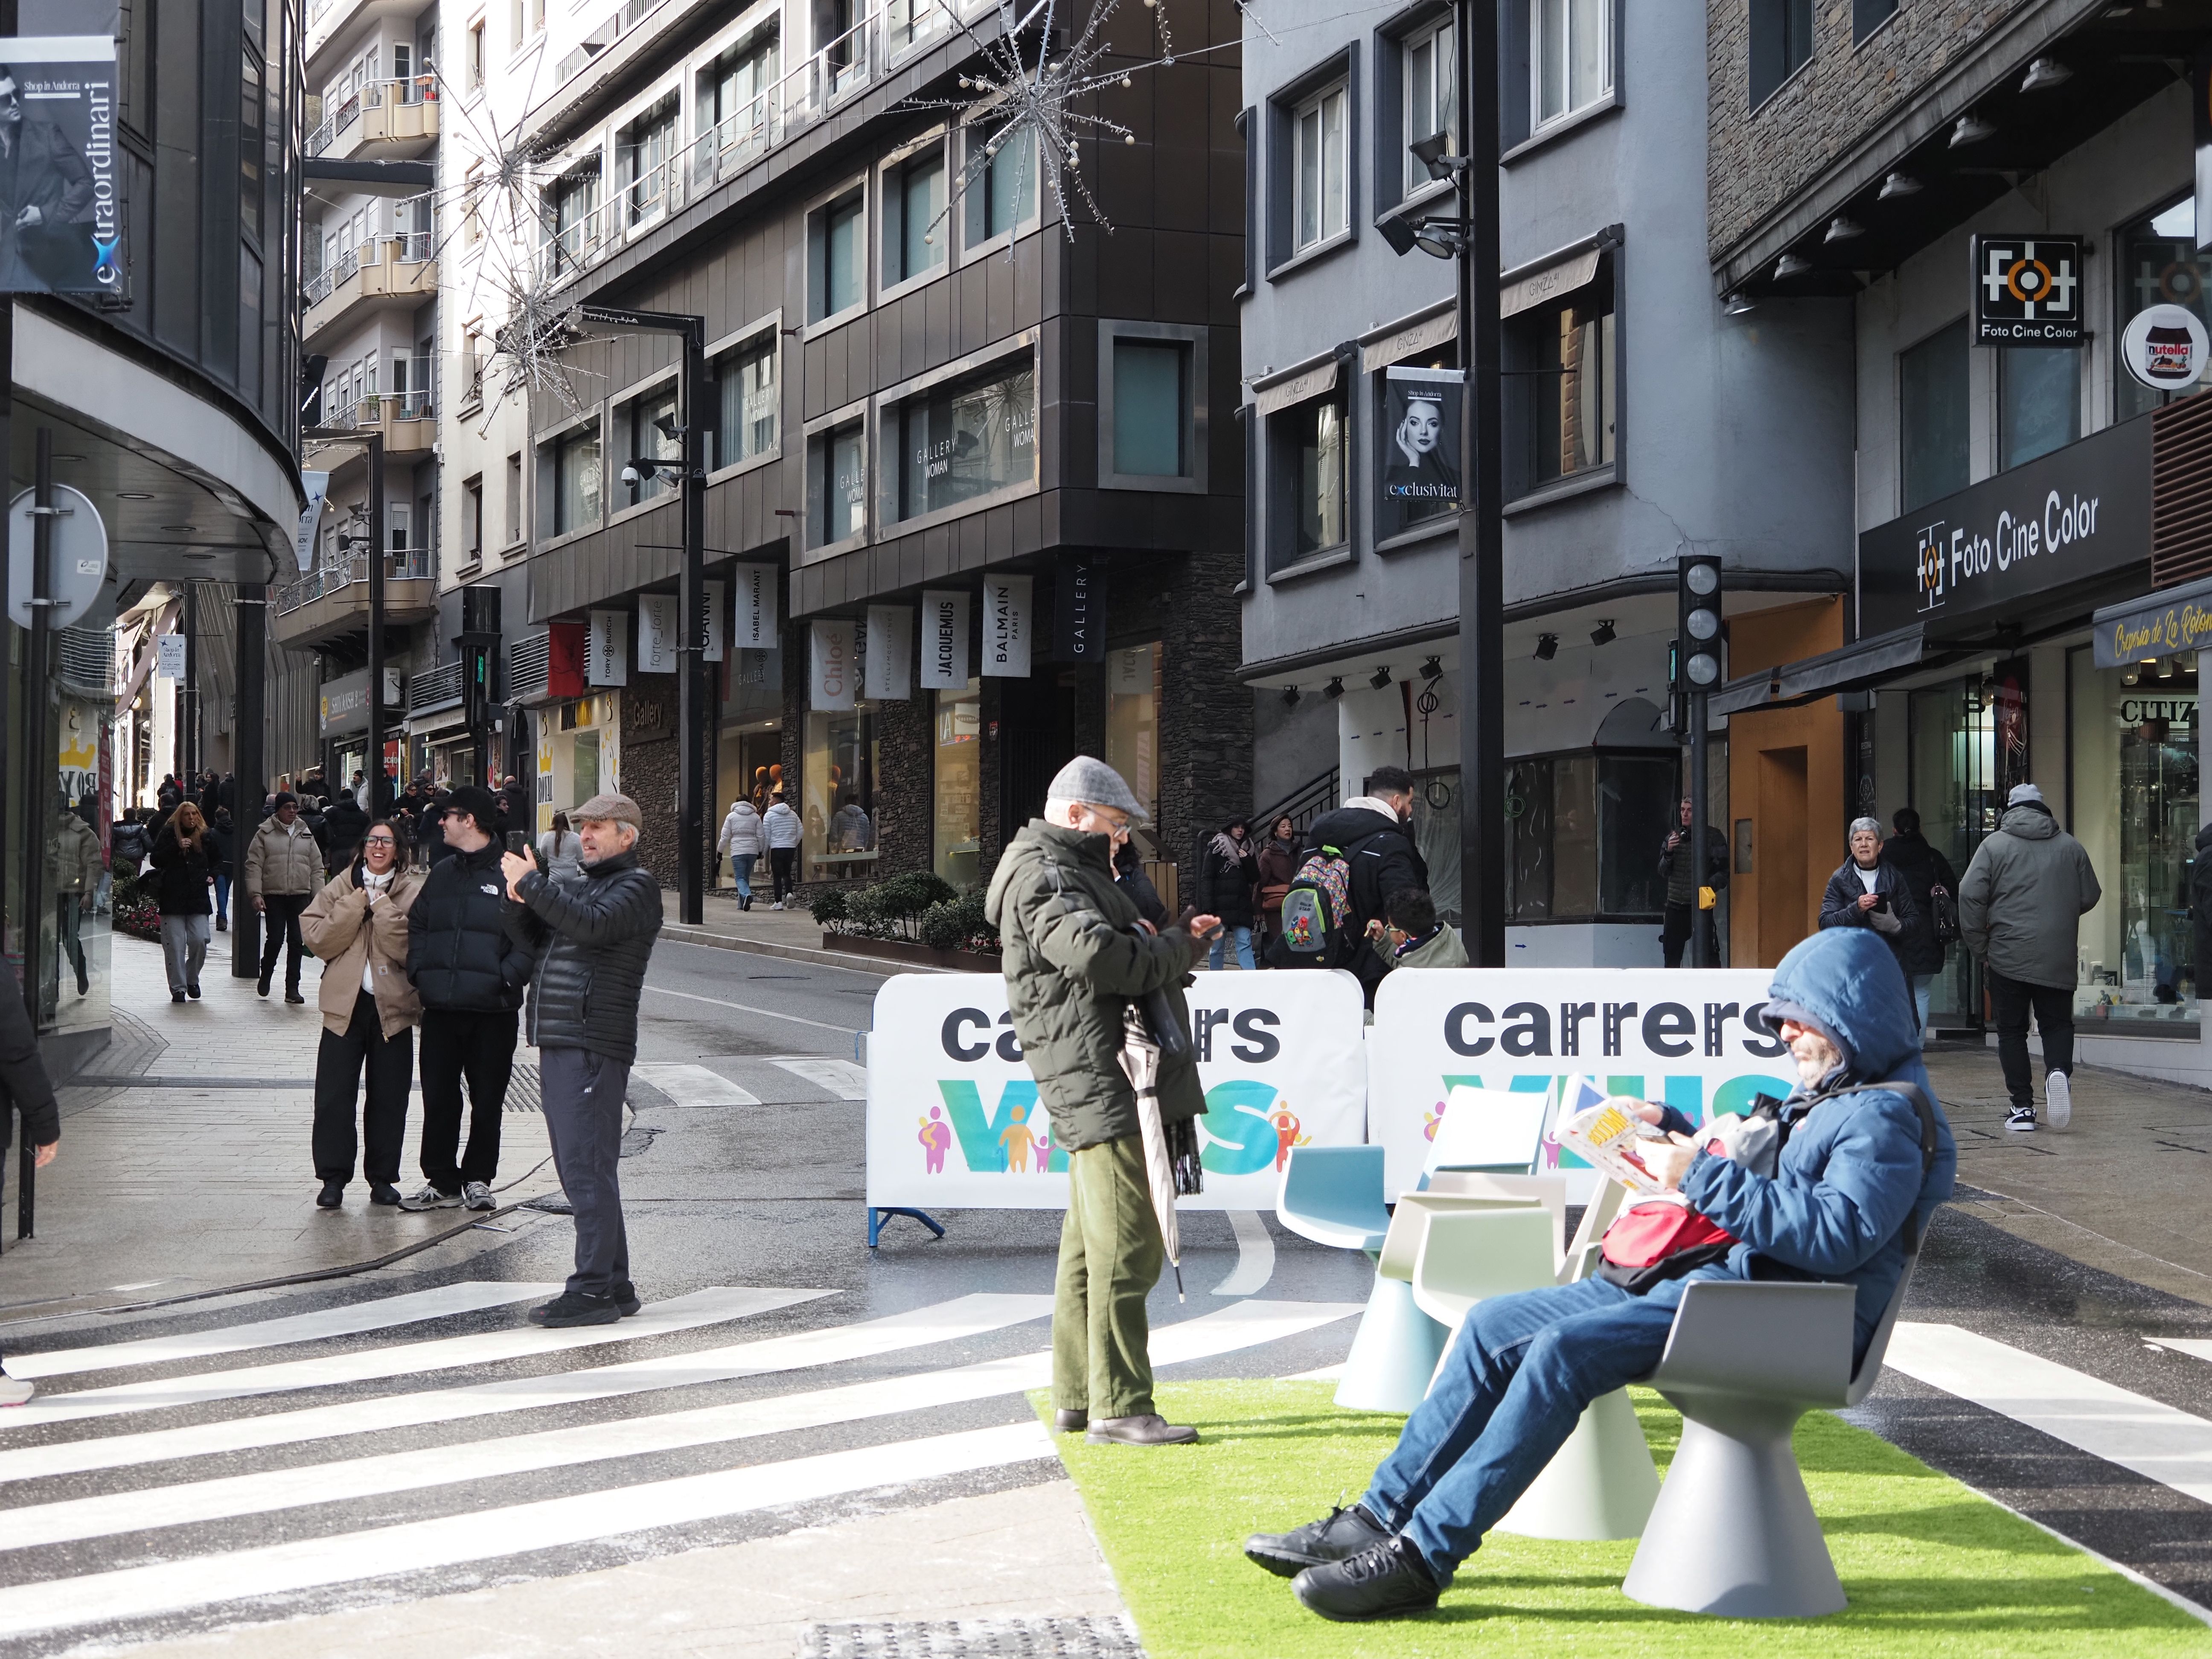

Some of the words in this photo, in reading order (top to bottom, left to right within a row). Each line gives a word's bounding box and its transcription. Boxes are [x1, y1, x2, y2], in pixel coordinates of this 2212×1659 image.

[24, 81, 43, 93] Shop
[44, 81, 50, 90] in
[51, 80, 80, 90] Andorra
[1530, 276, 1554, 296] GINZA
[1397, 332, 1419, 350] GINZA
[1982, 324, 2009, 338] Foto
[2012, 324, 2041, 338] Cine
[2044, 325, 2078, 339] Color
[2148, 343, 2188, 355] nutella
[745, 387, 774, 410] GALLERY
[1286, 381, 1304, 397] GINZA
[751, 405, 768, 424] WOMAN
[917, 437, 956, 463] GALLERY
[925, 458, 948, 479] WOMAN
[1389, 482, 1458, 498] exclusivitat
[1952, 528, 1991, 587] Foto
[1997, 510, 2039, 571] Cine
[2045, 490, 2098, 554] Color
[1074, 564, 1087, 654] GALLERY
[649, 601, 662, 667] forte_forte
[997, 587, 1009, 663] BALMAIN
[2115, 624, 2150, 660] Creperia
[2151, 617, 2162, 643] de
[2165, 610, 2178, 648] La
[938, 601, 953, 677] JACQUEMUS
[824, 633, 844, 697] Chloé
[332, 691, 354, 714] SHIVANSH
[634, 700, 662, 727] Gallery
[2121, 700, 2199, 722] CITIZ
[1861, 742, 1871, 750] FESTINA
[538, 775, 553, 803] ROYAL
[941, 1007, 1281, 1063] cars
[1444, 1002, 1790, 1058] carrers
